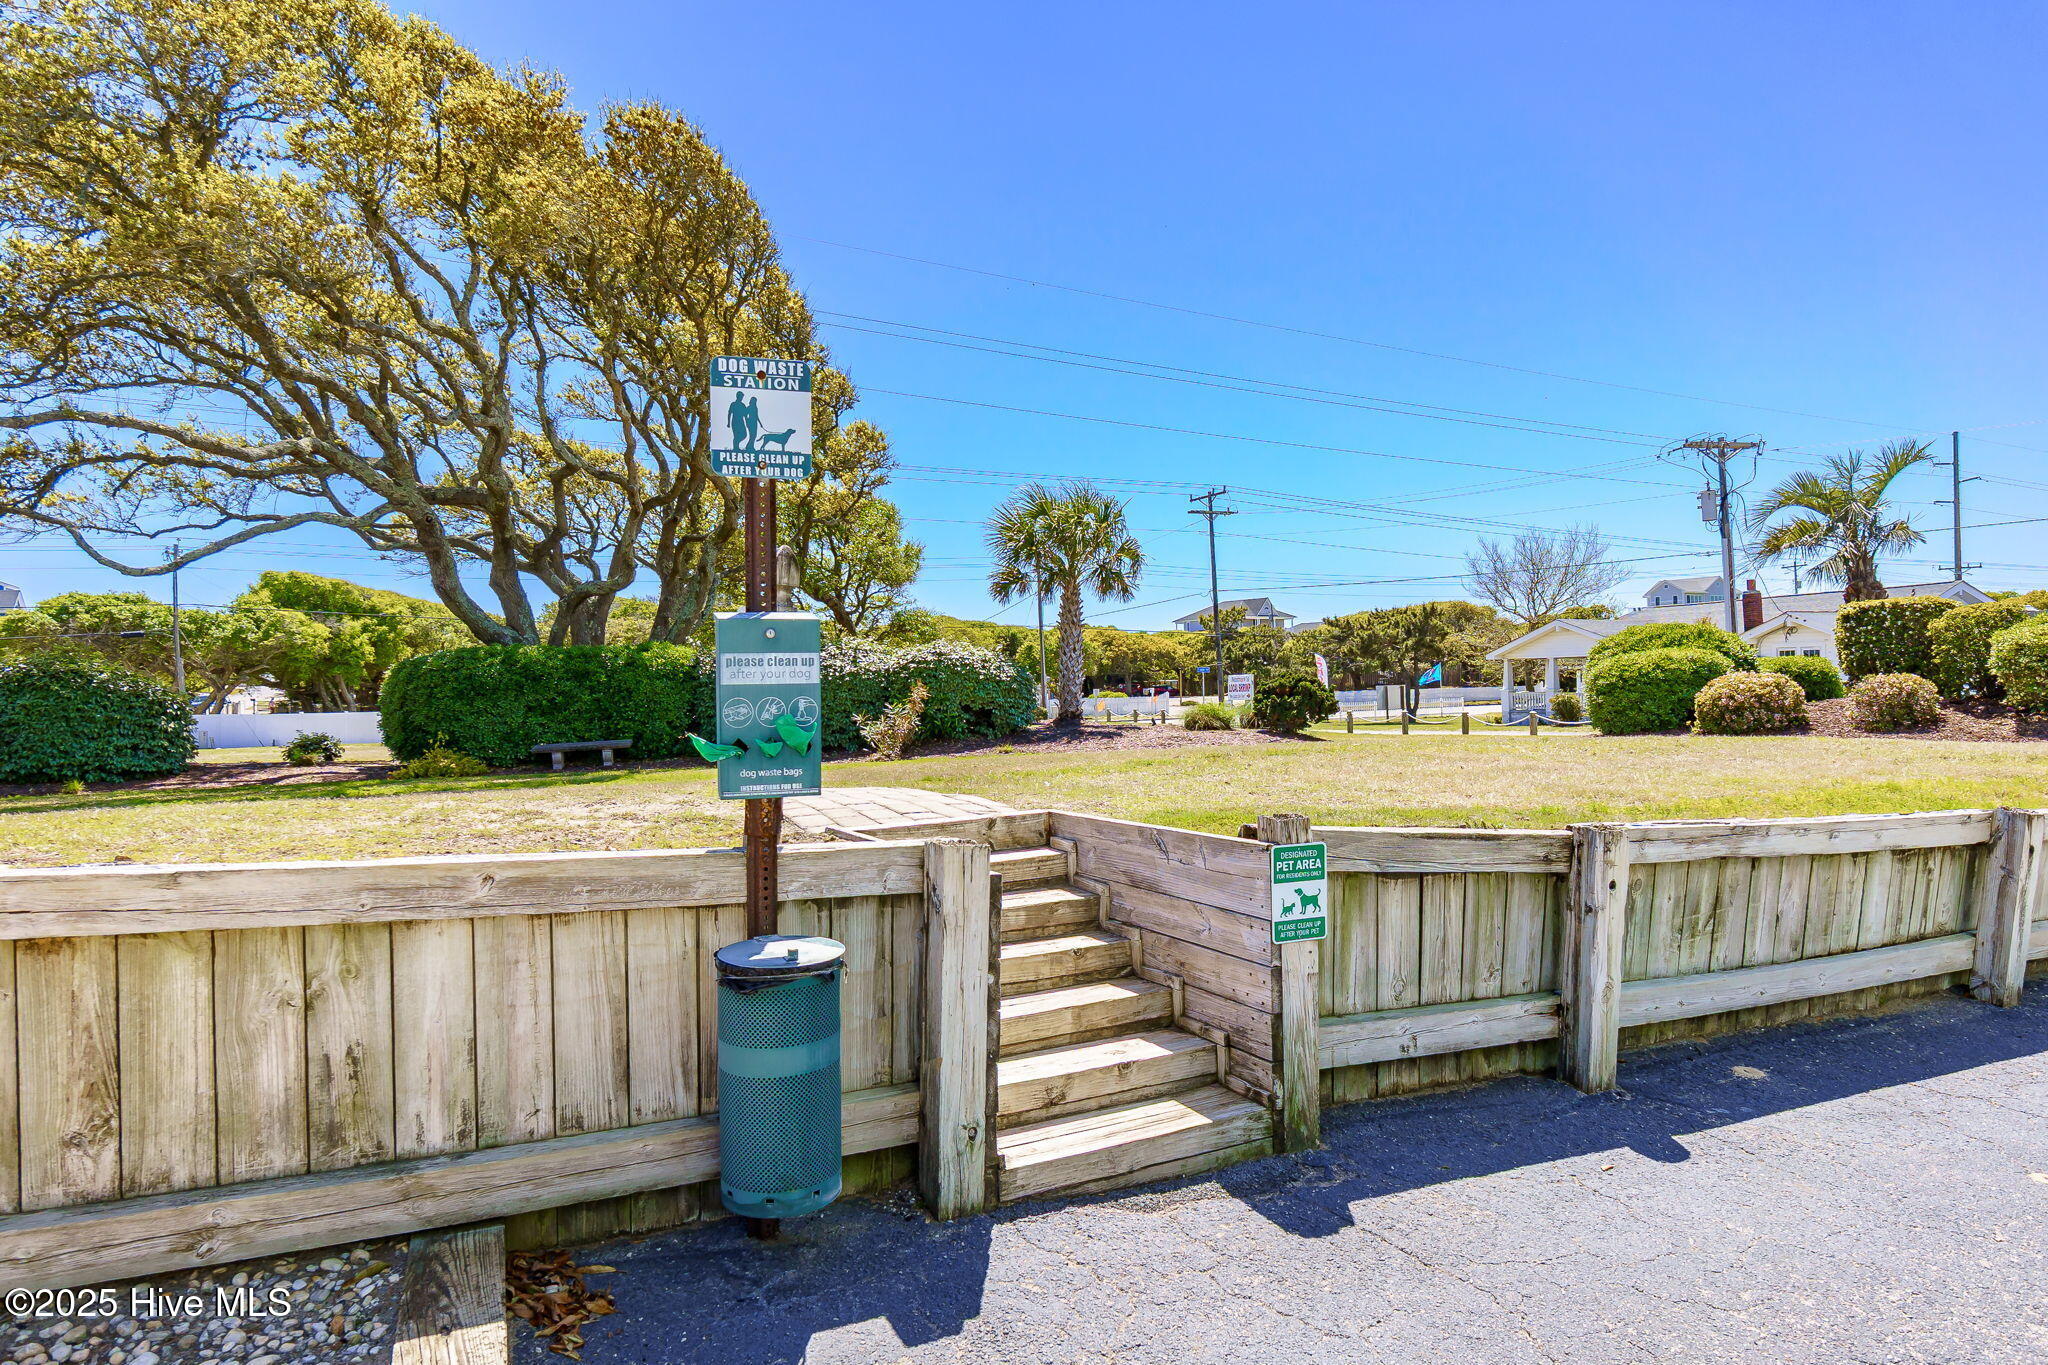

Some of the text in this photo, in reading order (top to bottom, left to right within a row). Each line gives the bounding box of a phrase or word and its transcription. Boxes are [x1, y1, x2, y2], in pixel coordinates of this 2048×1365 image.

[718, 357, 803, 376] DOG WASTE
[723, 375, 799, 390] STATION
[719, 452, 805, 465] PLEASE CLEAN UP
[721, 464, 804, 477] AFTER YOUR DOG
[725, 655, 815, 668] please clean up
[729, 667, 811, 681] after your dog
[740, 767, 803, 779] dog waste bags
[1280, 850, 1317, 859] DESIGNATED
[1276, 858, 1322, 872] PET AREA
[1286, 871, 1311, 879] RESIDENTS
[1278, 920, 1322, 931] PLEASE CLEAN UP
[1280, 927, 1320, 938] AFTER YOUR PET
